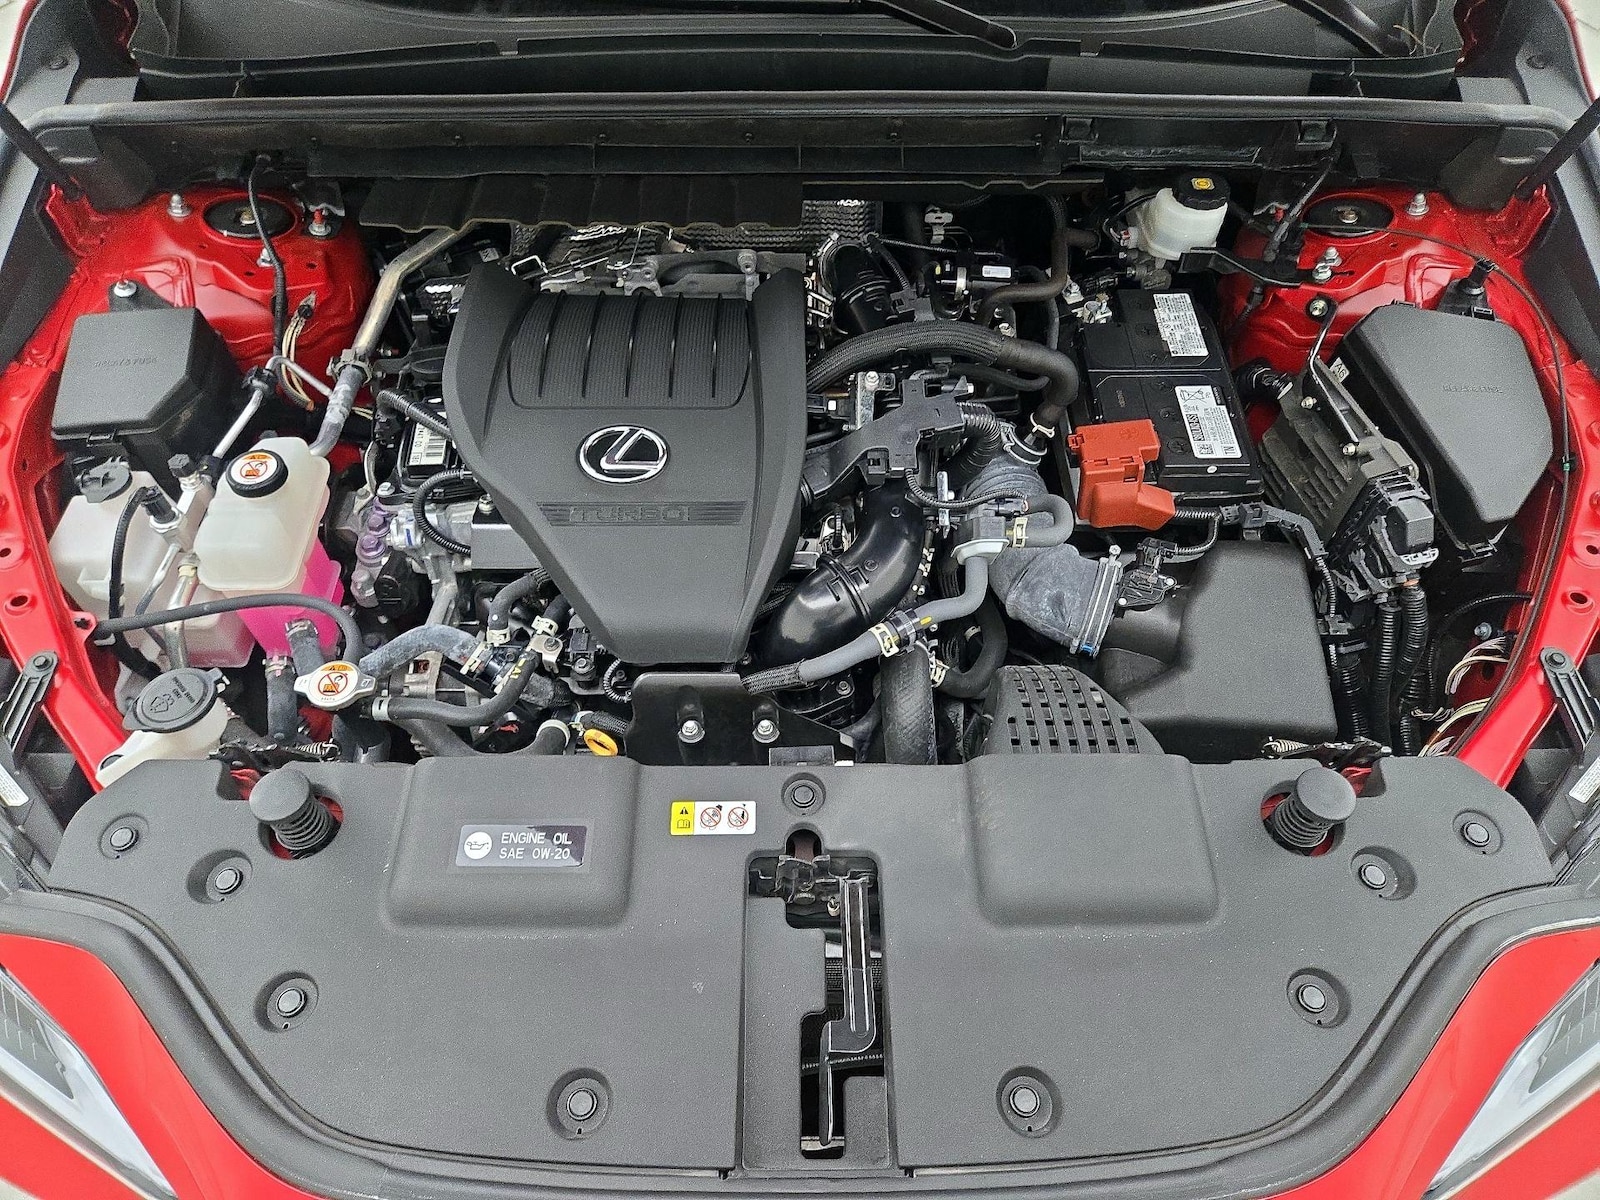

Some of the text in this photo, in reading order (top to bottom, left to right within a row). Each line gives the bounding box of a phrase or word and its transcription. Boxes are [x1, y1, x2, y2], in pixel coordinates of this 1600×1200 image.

[571, 505, 686, 522] TURBO
[501, 832, 573, 845] ENGINE OIL
[499, 847, 571, 860] SAE 0W-20
